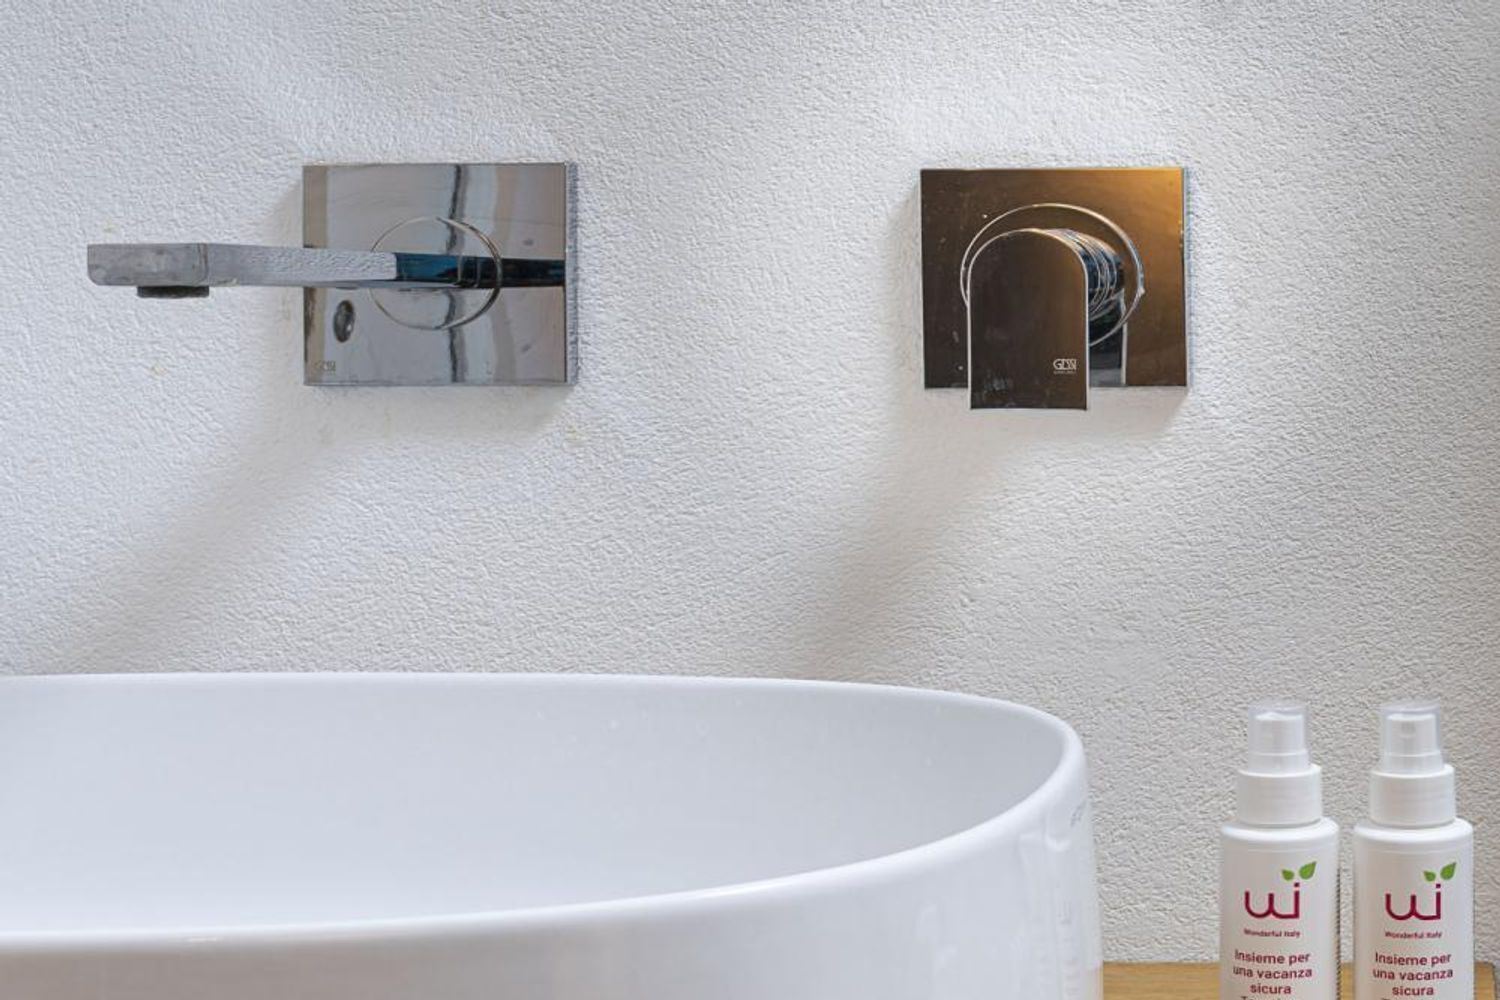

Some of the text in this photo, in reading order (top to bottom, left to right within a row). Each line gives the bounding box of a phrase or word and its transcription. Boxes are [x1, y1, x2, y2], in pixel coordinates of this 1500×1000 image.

[1235, 950, 1310, 967] Insieme per
[1375, 952, 1451, 969] Insieme per
[1233, 966, 1313, 980] una vacanza
[1373, 969, 1453, 981] una vacanza
[1250, 983, 1291, 995] sicura
[1392, 984, 1434, 996] sicura
